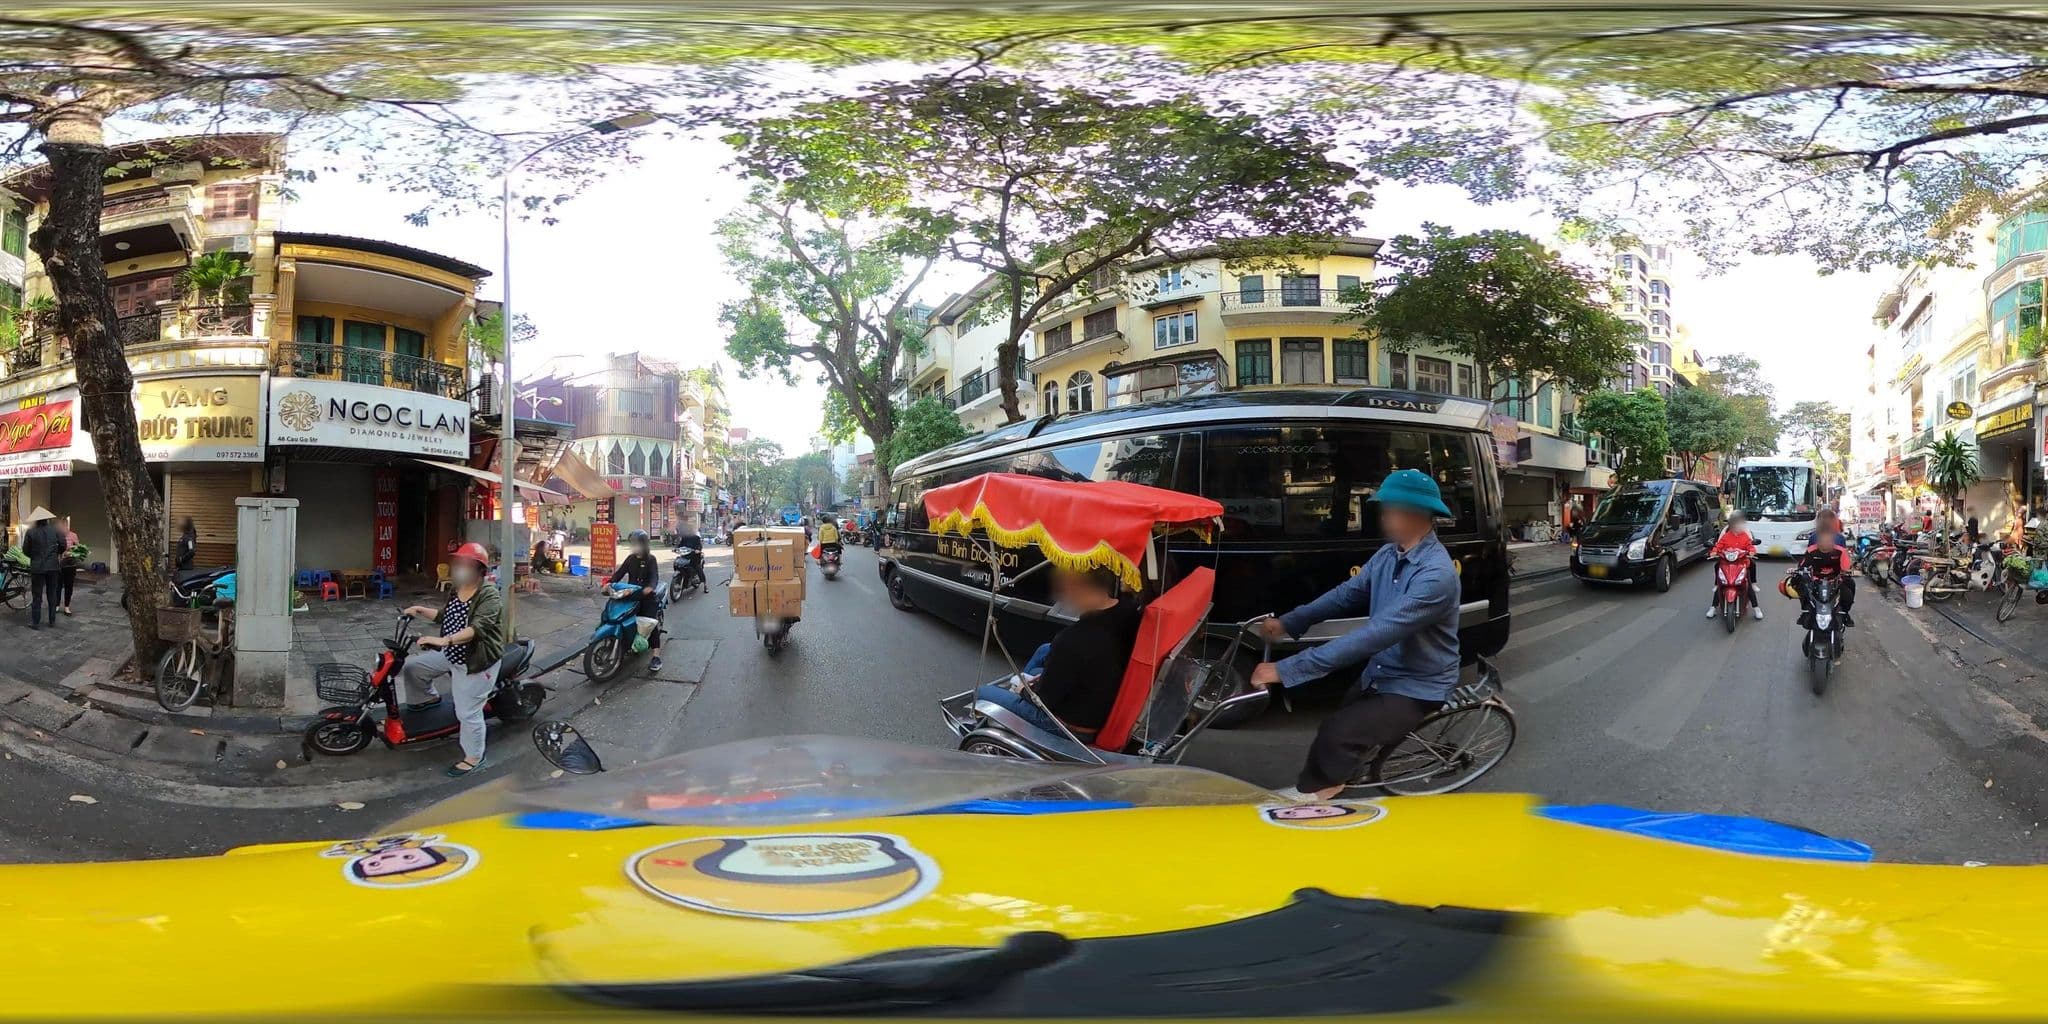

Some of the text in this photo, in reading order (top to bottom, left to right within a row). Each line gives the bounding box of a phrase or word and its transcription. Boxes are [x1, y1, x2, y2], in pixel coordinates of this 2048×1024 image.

[161, 385, 228, 408] VÀNG
[185, 416, 254, 439] TRUNG
[420, 409, 465, 434] LAN
[350, 427, 397, 439] DIAMOND
[407, 434, 443, 444] JEWELRY
[379, 526, 393, 540] LAN
[380, 547, 392, 560] 48
